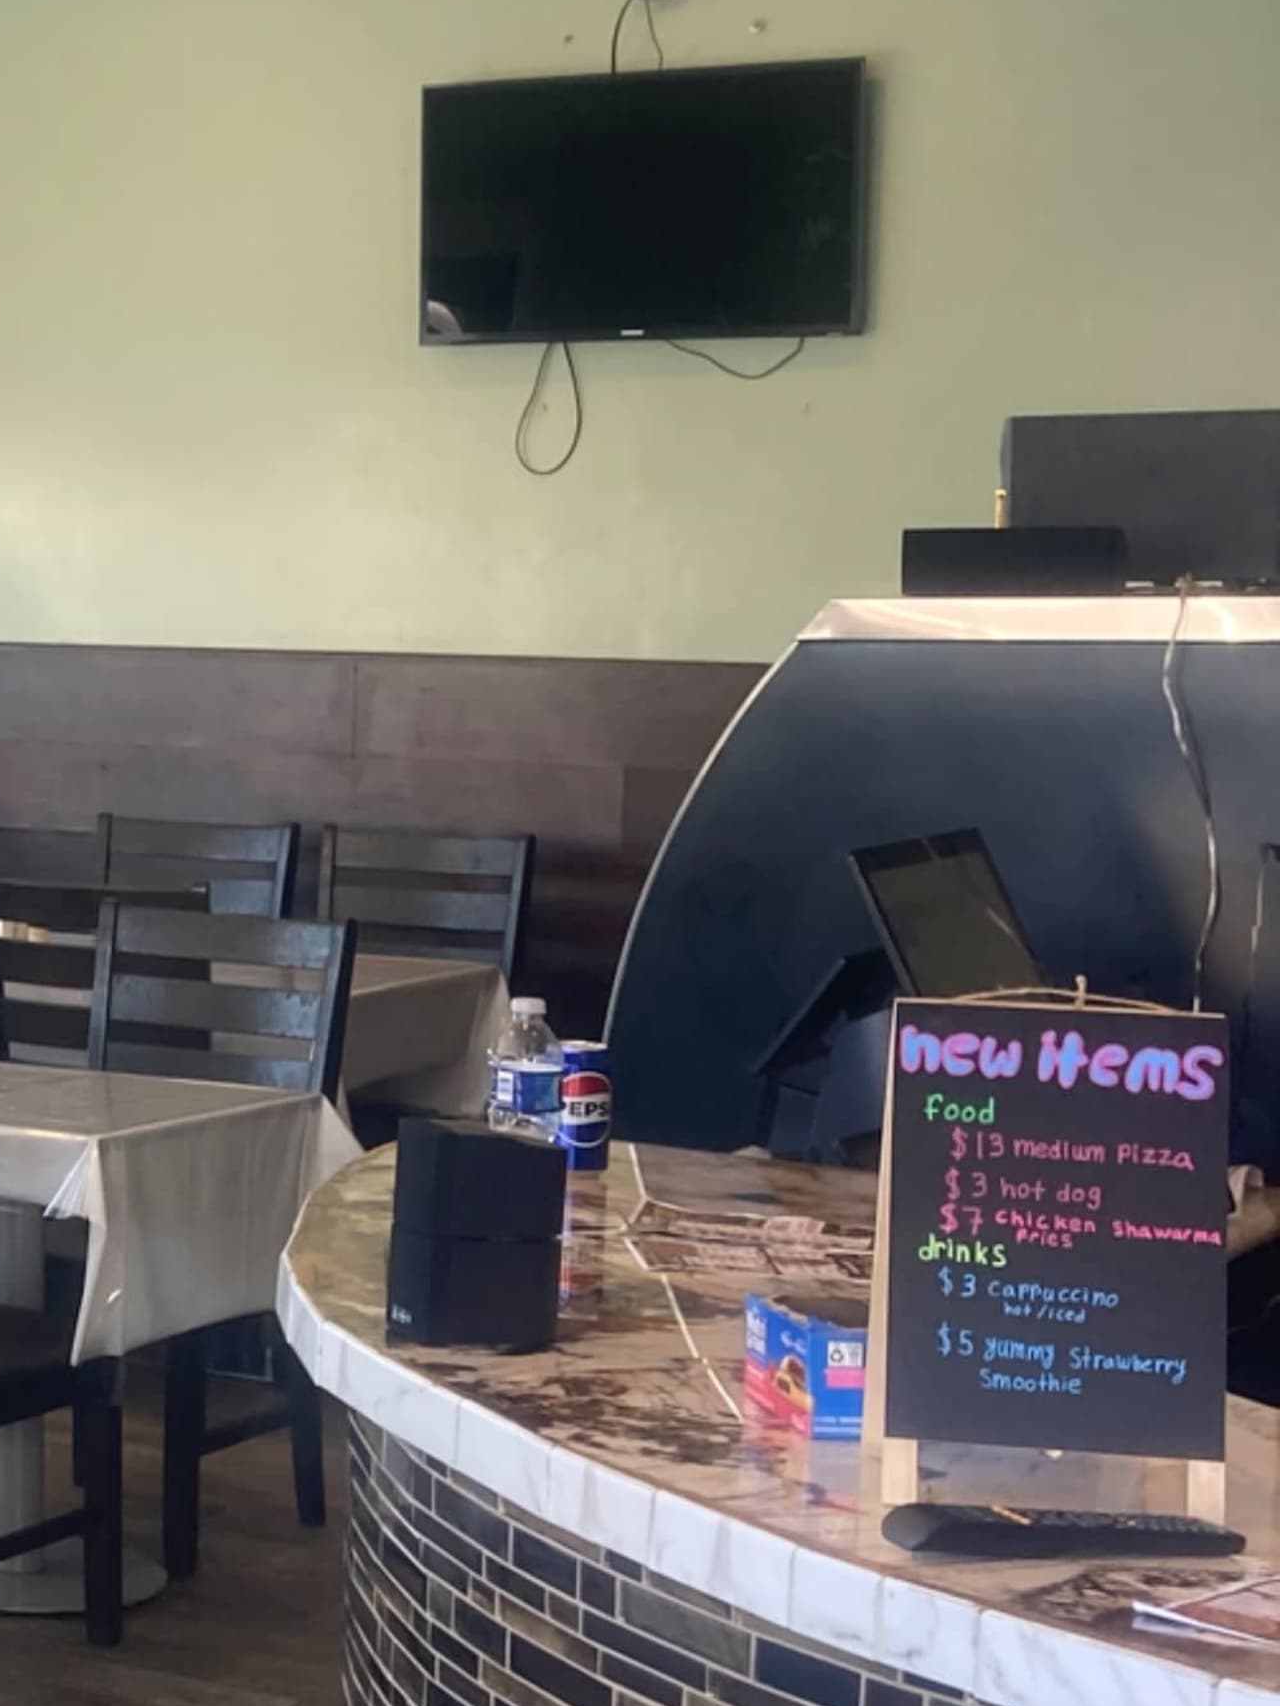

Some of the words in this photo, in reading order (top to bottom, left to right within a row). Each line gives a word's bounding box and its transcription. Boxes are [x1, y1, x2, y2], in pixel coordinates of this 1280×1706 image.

[899, 1024, 1022, 1079] new
[1038, 1029, 1224, 1101] items
[560, 1101, 609, 1119] EPS
[924, 1093, 995, 1124] food
[1013, 1139, 1105, 1164] medium
[1000, 1176, 1046, 1201] hot
[1056, 1183, 1102, 1211] dog
[918, 1232, 1008, 1269] drinks
[982, 1336, 1056, 1371] yummy
